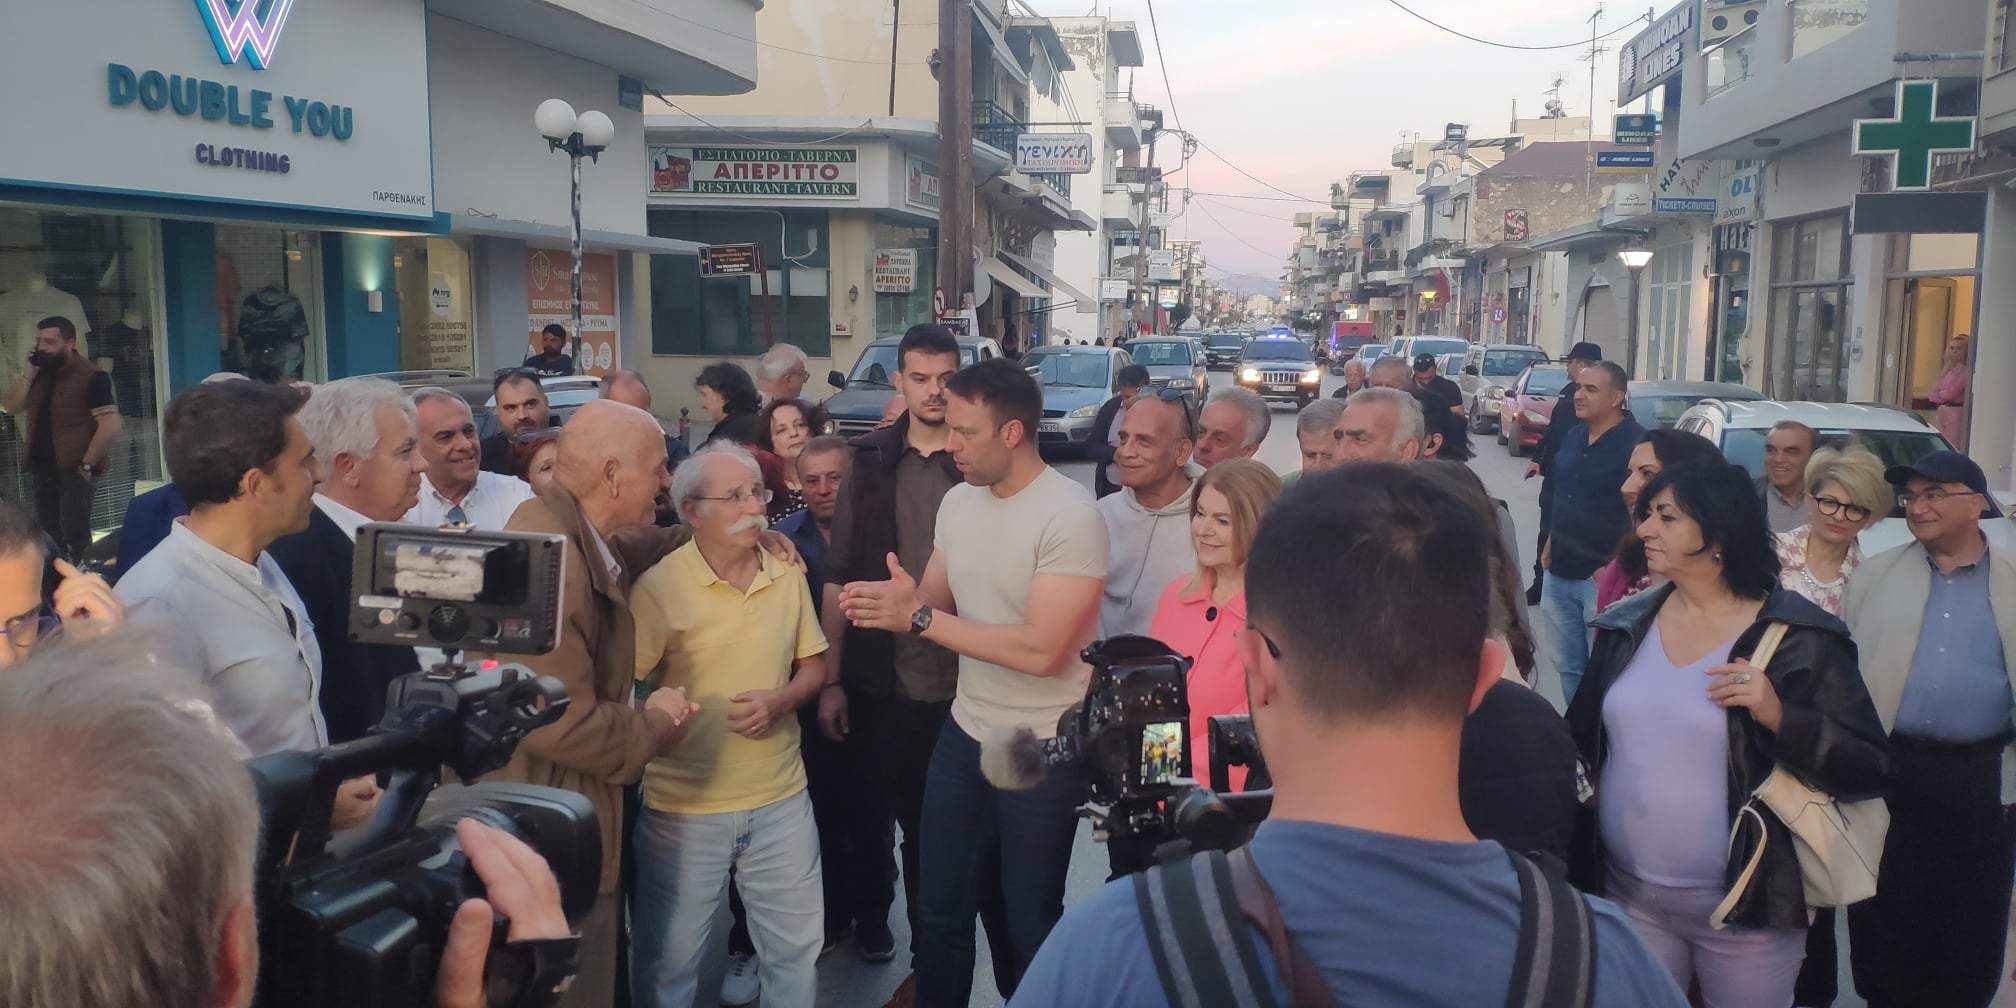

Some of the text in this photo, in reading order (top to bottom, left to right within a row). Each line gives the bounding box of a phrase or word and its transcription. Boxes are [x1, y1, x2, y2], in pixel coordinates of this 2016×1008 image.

[1637, 6, 1693, 60] MINOAN
[1644, 42, 1682, 84] LINES
[107, 63, 354, 140] DOUBLE YOU
[195, 143, 291, 174] CLOTHING
[698, 149, 780, 161] ΕΣΤΙΑΤΟΡΙΟ
[713, 162, 839, 181] ΑΠΕΡΙΤΤΟ
[1659, 157, 1685, 193] HAT
[698, 182, 851, 194] RESTAURANT-TAVERN
[372, 190, 427, 206] ΠΑΡΘΕΝΑΚΗΣ
[1659, 199, 1715, 210] TICKETS-CRUISES
[1722, 206, 1746, 219] axon
[875, 267, 912, 276] RESTAURANT
[875, 275, 911, 284] APERITTO
